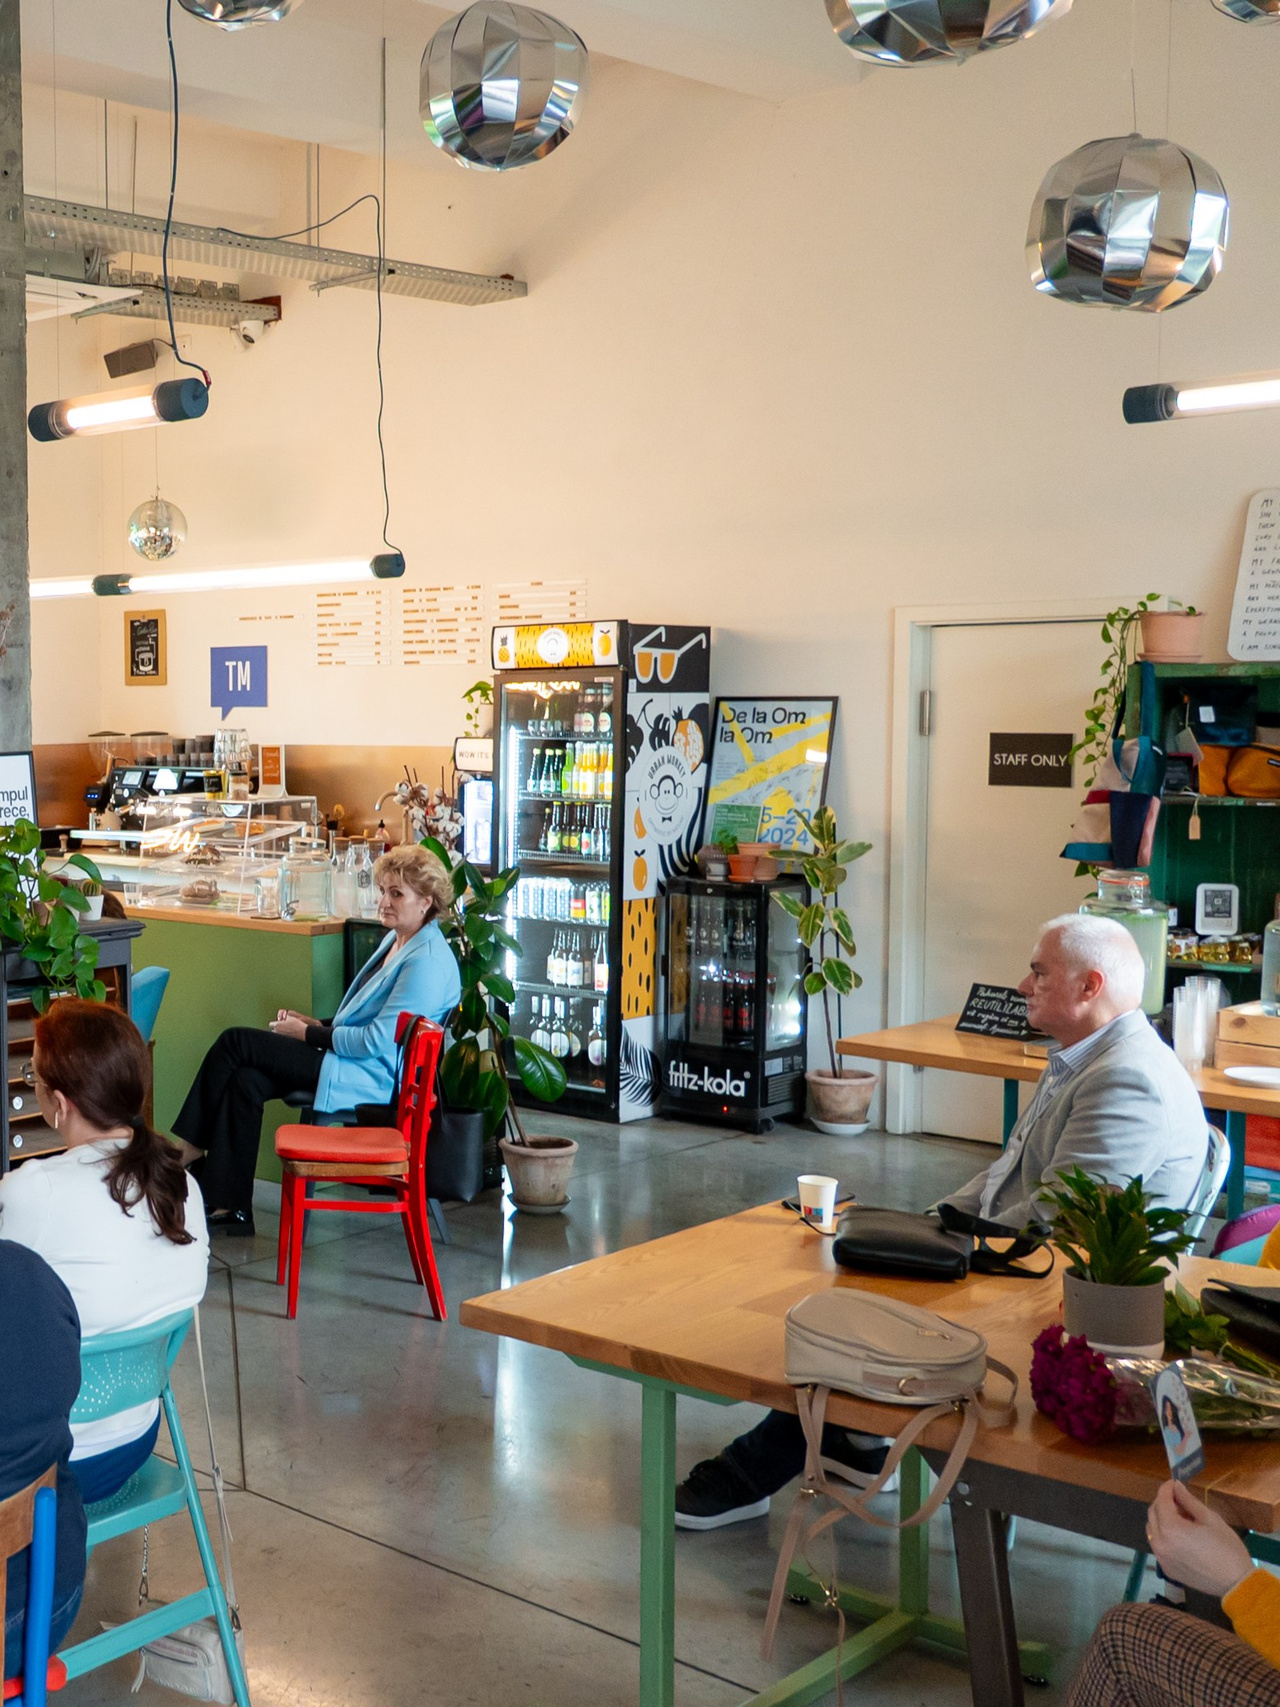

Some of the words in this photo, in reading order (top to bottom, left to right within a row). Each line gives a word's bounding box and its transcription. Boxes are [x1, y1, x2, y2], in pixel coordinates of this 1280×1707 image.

[224, 660, 251, 692] TM
[722, 707, 747, 724] De
[751, 706, 767, 724] la
[772, 706, 807, 724] Om
[719, 726, 735, 743] la
[740, 726, 773, 744] Om
[993, 753, 1028, 766] STAFF
[1030, 754, 1068, 767] ONLY
[757, 827, 809, 845] 2024
